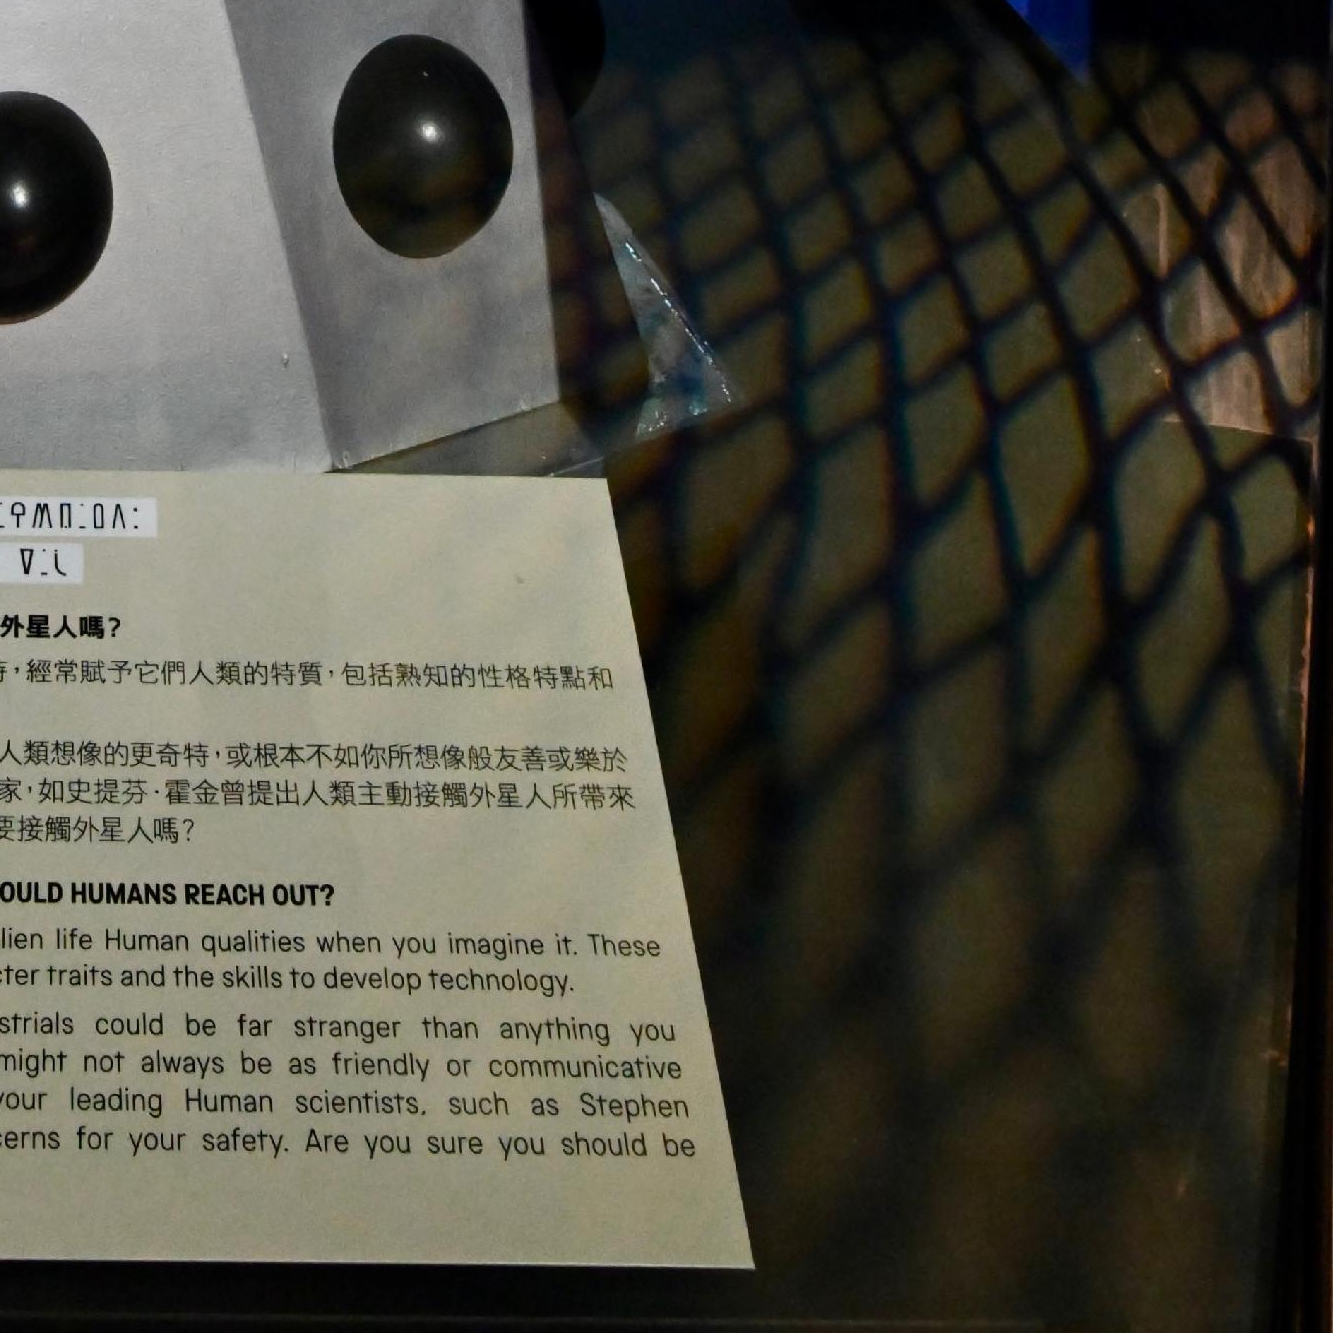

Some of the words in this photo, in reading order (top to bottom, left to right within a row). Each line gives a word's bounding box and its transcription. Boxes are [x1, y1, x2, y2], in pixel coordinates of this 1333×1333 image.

[72, 882, 177, 904] HUMANS
[185, 884, 264, 906] REACH
[273, 884, 334, 906] OUT?
[57, 928, 92, 950] life
[106, 929, 188, 951] Human
[202, 930, 304, 957] qualities
[317, 931, 380, 952] when
[393, 937, 435, 959] you
[448, 933, 543, 960] imagine
[556, 934, 577, 955] it.
[588, 934, 660, 956] These
[47, 964, 112, 986] traits
[121, 965, 165, 987] and
[173, 965, 213, 987] the
[223, 966, 282, 988] skills
[290, 967, 314, 988] to
[324, 966, 421, 995] develop
[428, 968, 573, 997] technology.
[96, 1013, 163, 1036] could
[186, 1013, 215, 1036] be
[238, 1014, 272, 1036] far
[295, 1016, 400, 1044] stranger
[422, 1016, 478, 1038] than
[500, 1017, 609, 1046] anything
[630, 1024, 675, 1046] you
[84, 1052, 124, 1073] not
[142, 1050, 223, 1079] always
[241, 1050, 271, 1074] be
[289, 1058, 316, 1075] as
[332, 1052, 429, 1082] friendly
[447, 1059, 471, 1076] or
[489, 1055, 681, 1079] communicative
[71, 1086, 162, 1118] leading
[186, 1088, 272, 1112] Human
[296, 1090, 425, 1115] scientists,
[449, 1091, 509, 1115] such
[532, 1098, 559, 1116] as
[580, 1092, 688, 1123] Stephen
[77, 1126, 113, 1150] for
[129, 1133, 186, 1156] your
[203, 1127, 288, 1159] safety.
[305, 1129, 348, 1153] Are
[364, 1135, 411, 1159] you
[428, 1136, 482, 1154] sure
[498, 1137, 545, 1161] you
[561, 1132, 647, 1156] should
[663, 1133, 695, 1157] be
